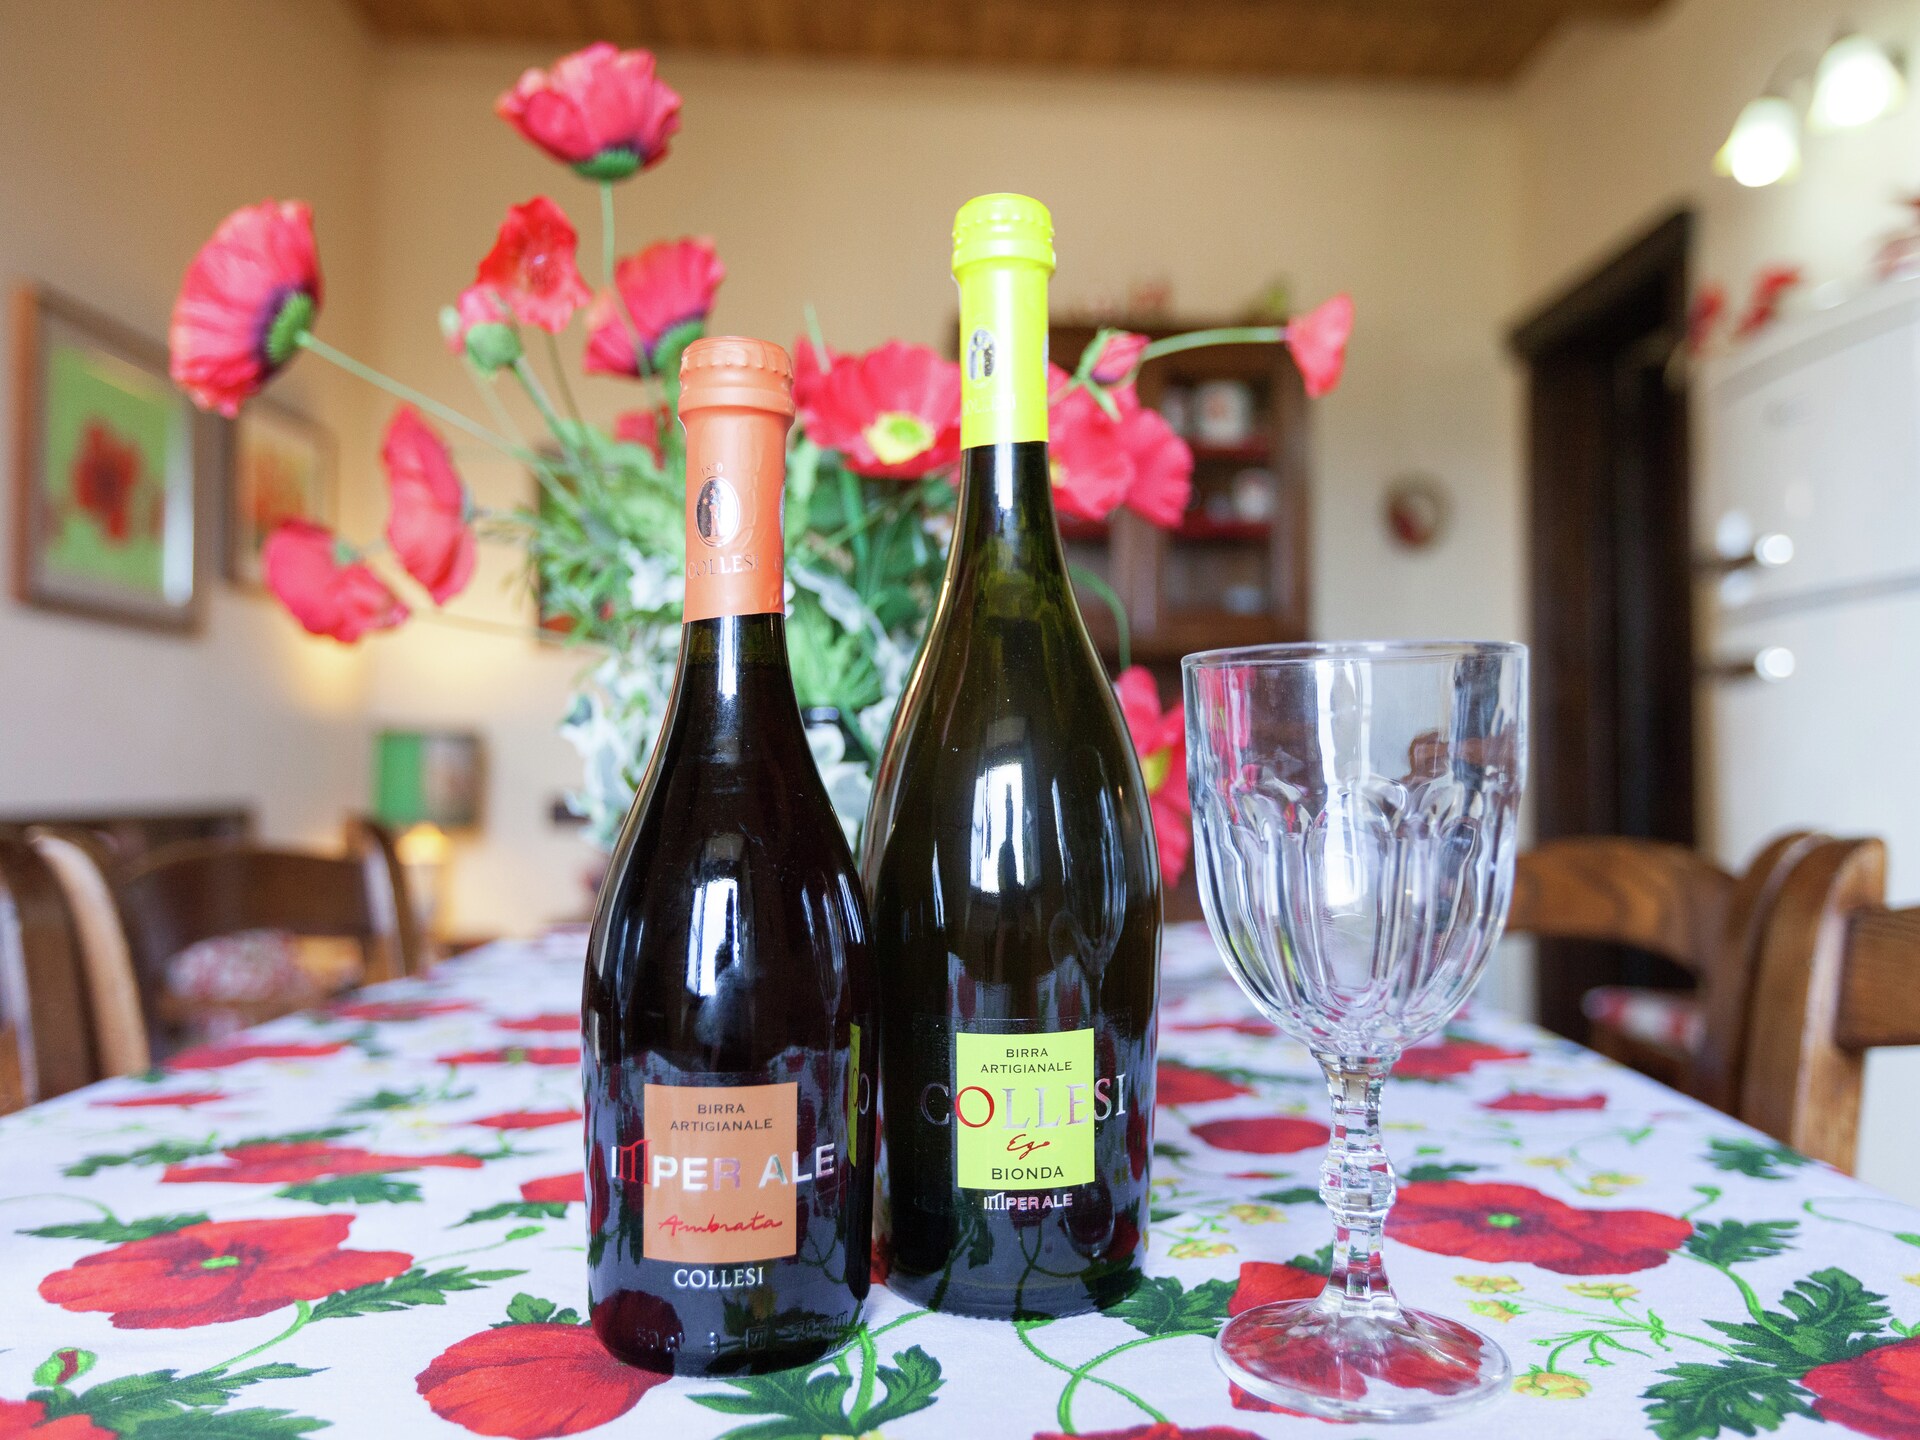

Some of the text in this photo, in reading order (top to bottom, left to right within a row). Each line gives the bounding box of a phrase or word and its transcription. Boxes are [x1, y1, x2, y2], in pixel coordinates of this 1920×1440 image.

[1005, 1048, 1049, 1058] BIRRA
[980, 1061, 1073, 1074] ARTIGIANALE
[920, 1074, 1127, 1128] COLLESI
[697, 1103, 746, 1114] BIRRA
[670, 1118, 773, 1132] ARTIGIANALE
[991, 1166, 1064, 1180] BIONDA
[658, 1211, 783, 1237] Ambrata
[673, 1267, 765, 1289] COLLESI
